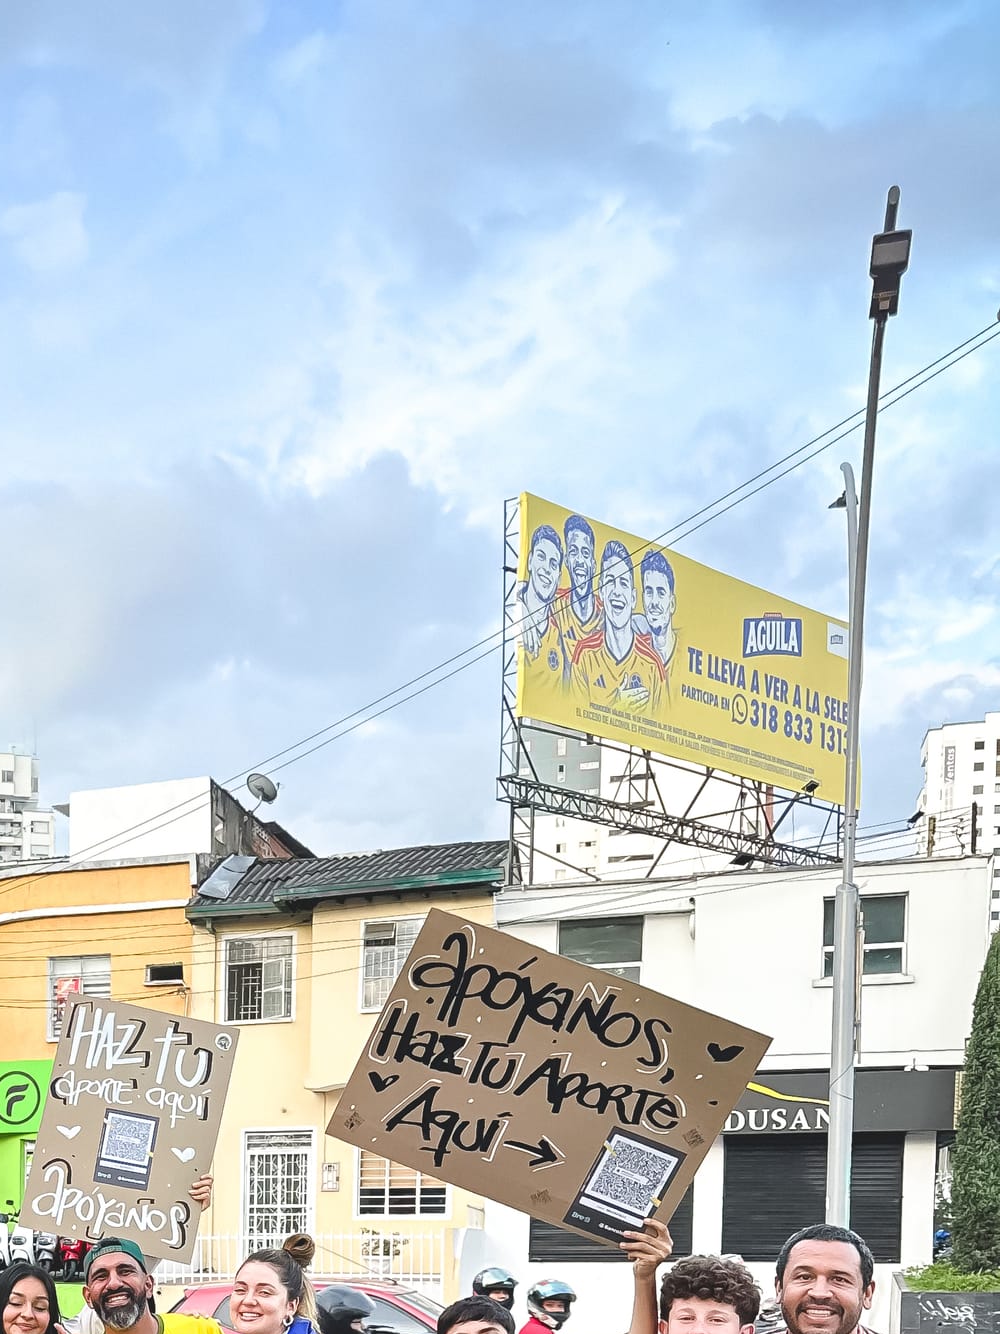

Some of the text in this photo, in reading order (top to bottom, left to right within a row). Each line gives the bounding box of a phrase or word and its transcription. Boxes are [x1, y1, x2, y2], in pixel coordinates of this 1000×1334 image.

[745, 620, 799, 654] AGUILA
[688, 647, 703, 676] TE
[707, 653, 746, 690] LLEVA
[750, 669, 760, 695] A
[765, 673, 788, 704] VER
[793, 684, 802, 709] A
[806, 687, 820, 716] LA
[681, 683, 719, 708] PARTICIPA
[721, 695, 730, 711] EN
[750, 699, 778, 733] 318
[784, 710, 813, 744] 833
[69, 1006, 144, 1070] HAZ
